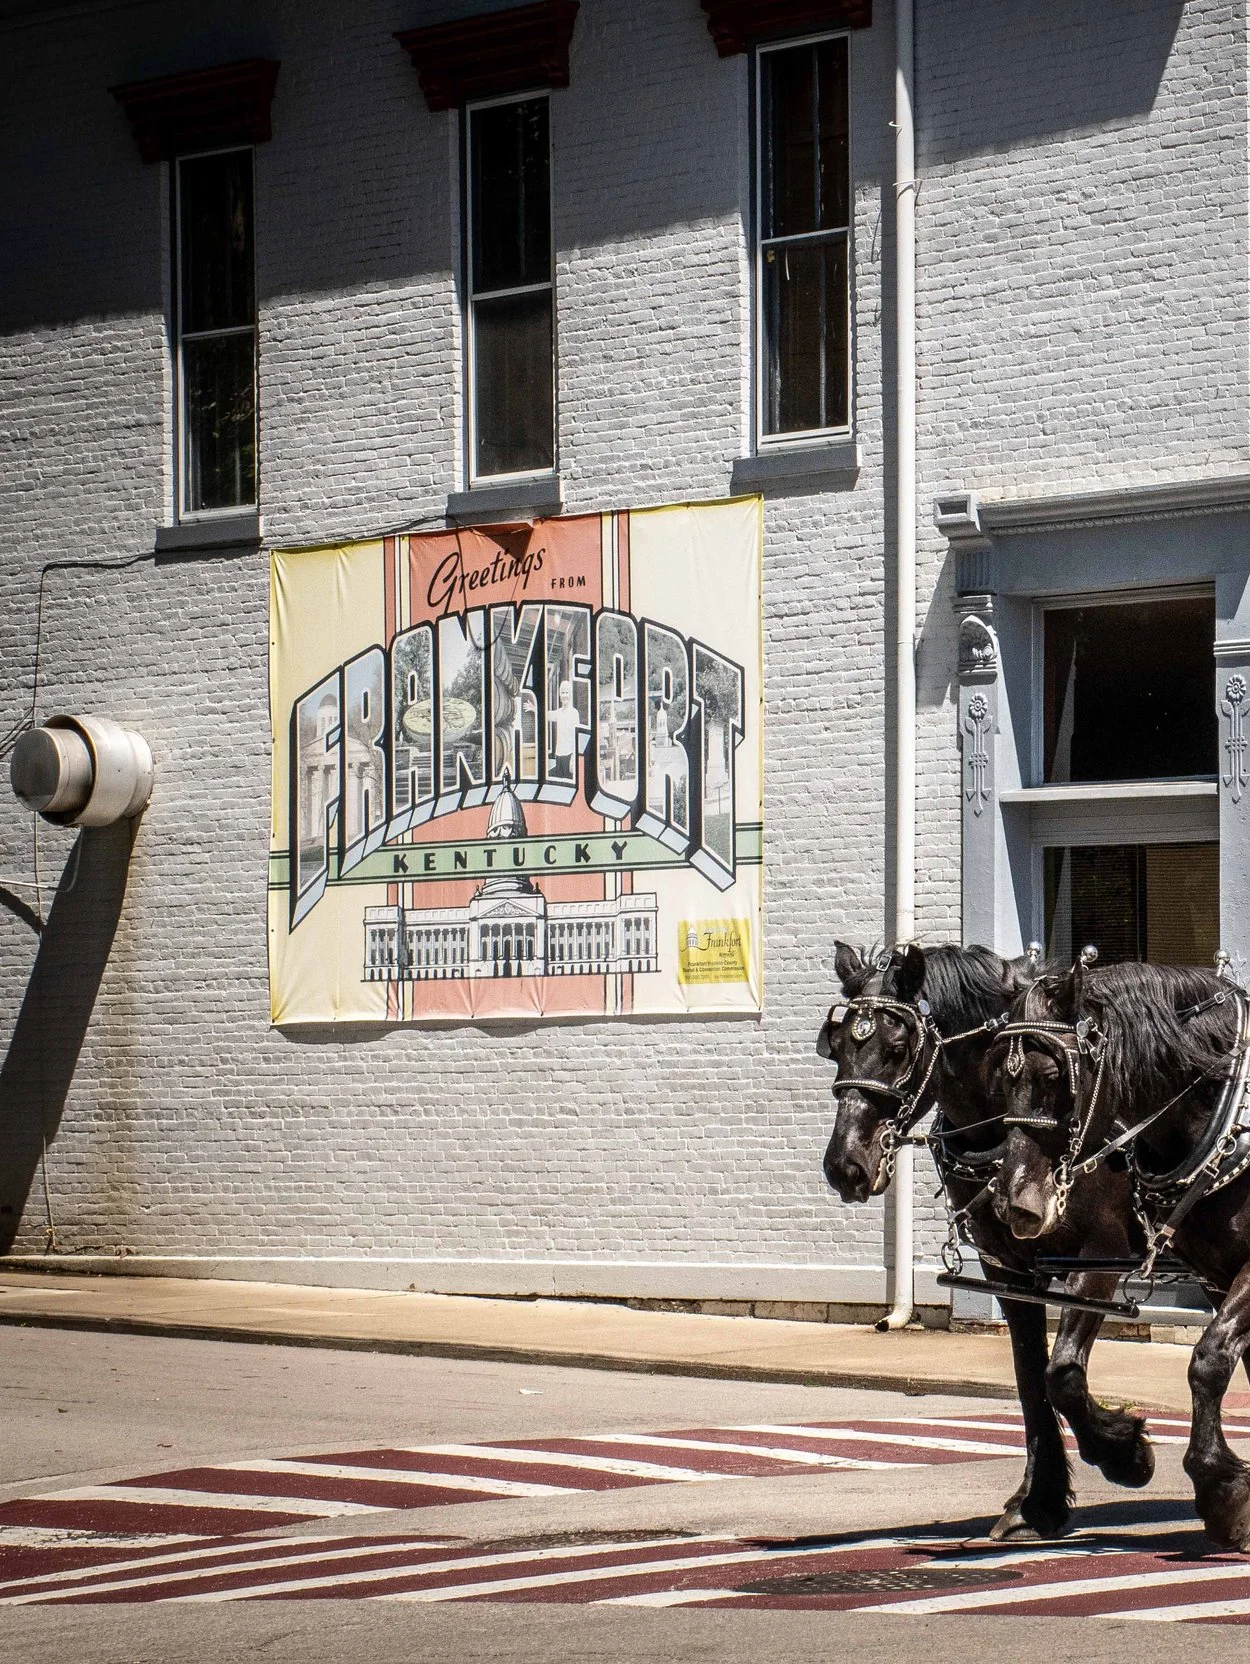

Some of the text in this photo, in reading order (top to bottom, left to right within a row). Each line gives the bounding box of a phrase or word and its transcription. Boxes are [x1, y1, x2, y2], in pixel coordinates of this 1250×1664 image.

[427, 547, 586, 614] Greetings FROM
[290, 600, 745, 934] FRANKFORT
[393, 840, 628, 874] KENTUCKY
[699, 931, 742, 952] Frankfort
